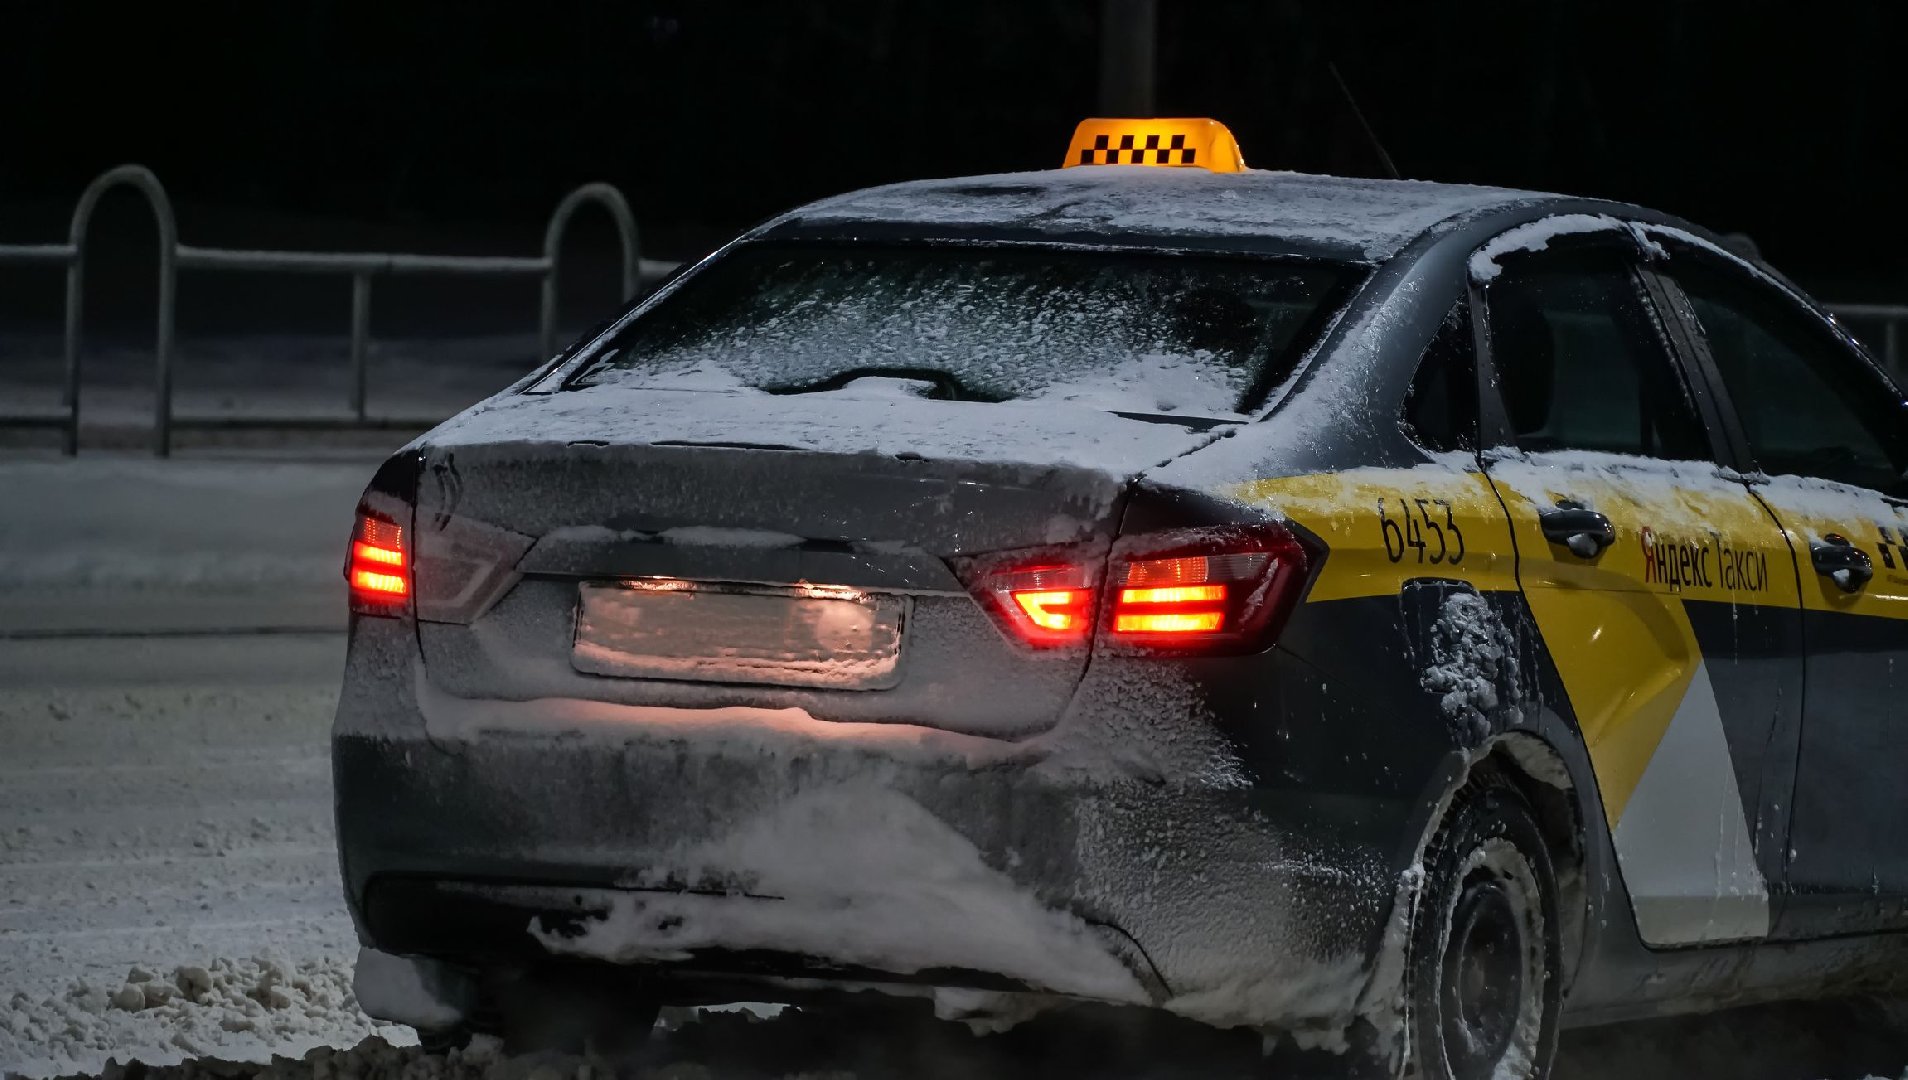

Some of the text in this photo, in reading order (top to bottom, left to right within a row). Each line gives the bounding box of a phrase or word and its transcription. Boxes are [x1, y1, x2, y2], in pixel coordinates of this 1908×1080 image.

[1377, 497, 1464, 565] 6453
[1641, 526, 1768, 592] Яндекс Такси
